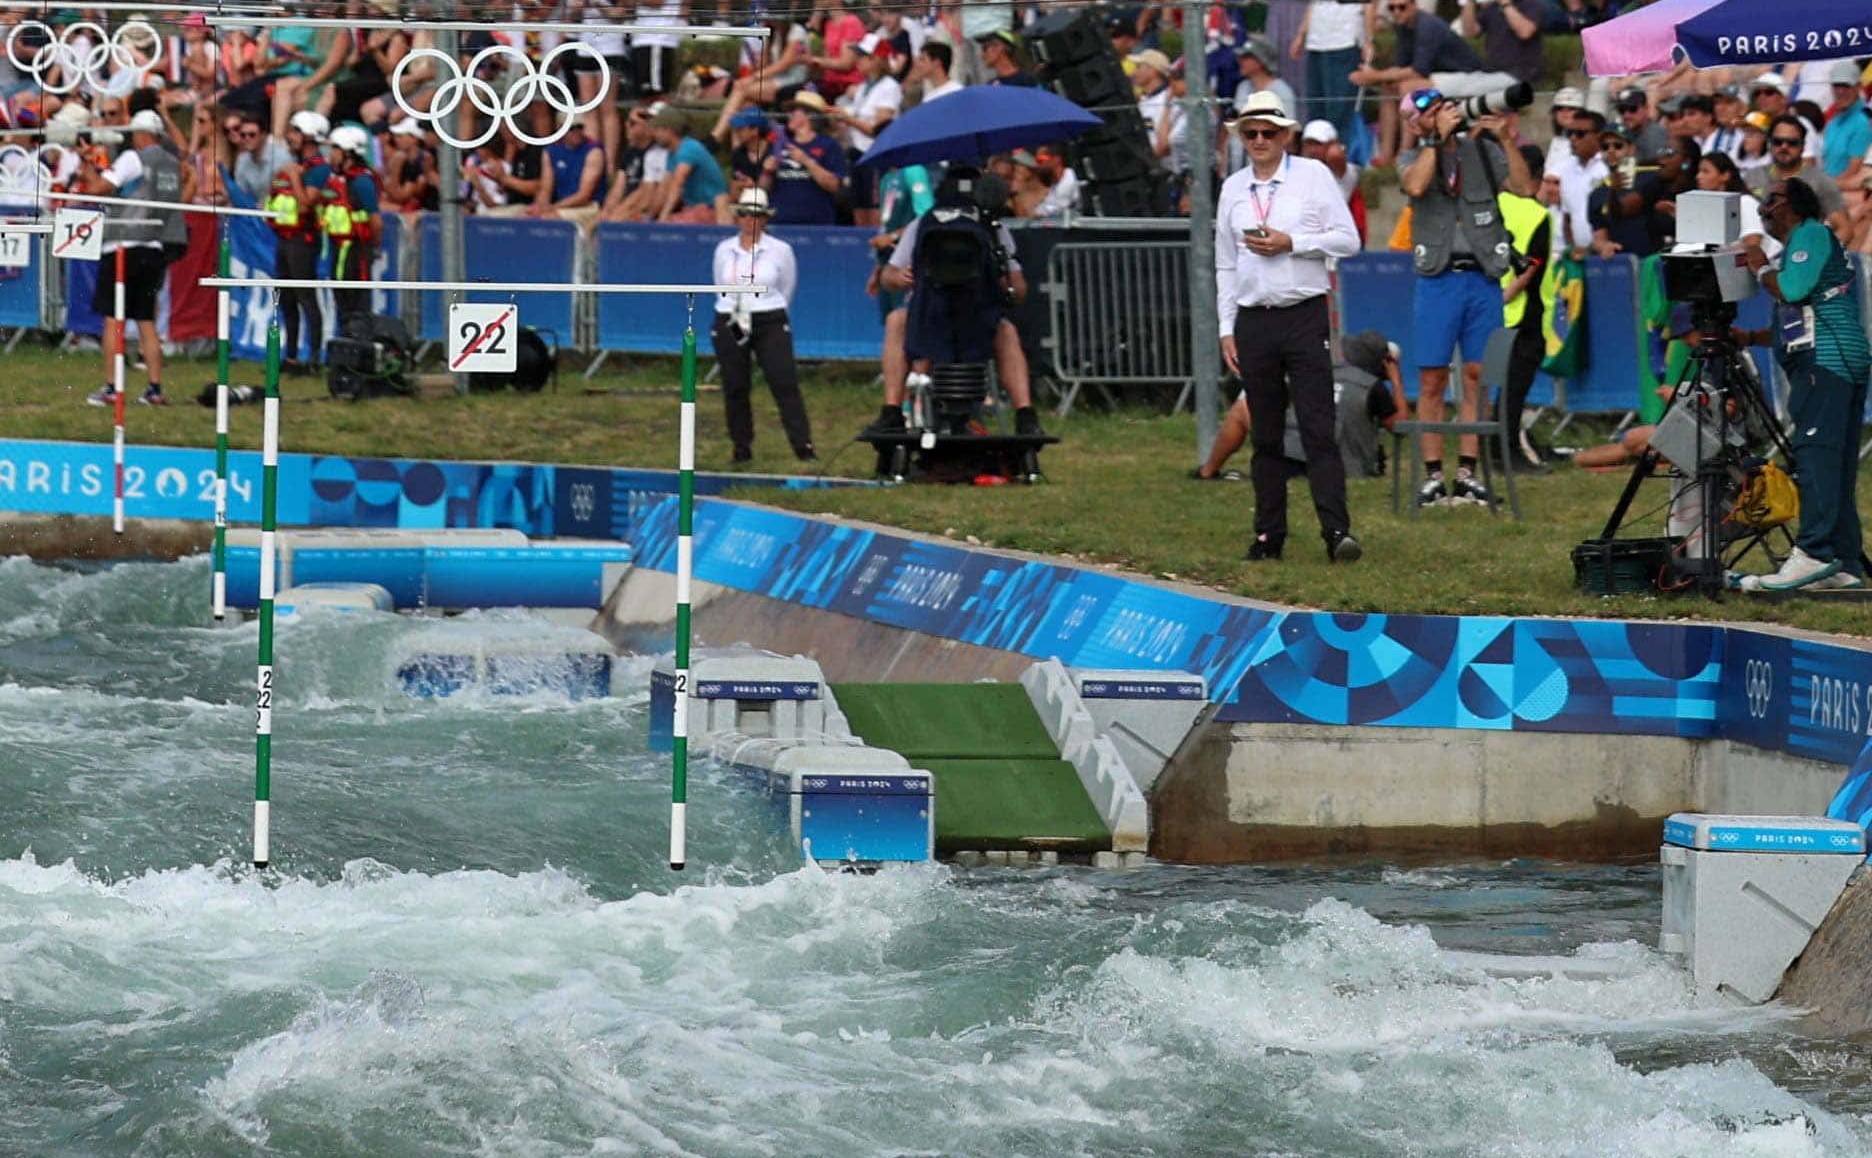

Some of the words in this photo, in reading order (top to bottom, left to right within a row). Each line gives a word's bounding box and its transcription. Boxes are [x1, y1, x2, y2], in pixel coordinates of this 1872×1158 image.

[65, 223, 92, 246] 19
[1, 237, 19, 256] 17
[460, 322, 507, 354] 22
[125, 466, 251, 502] 2024
[263, 671, 272, 688] 2
